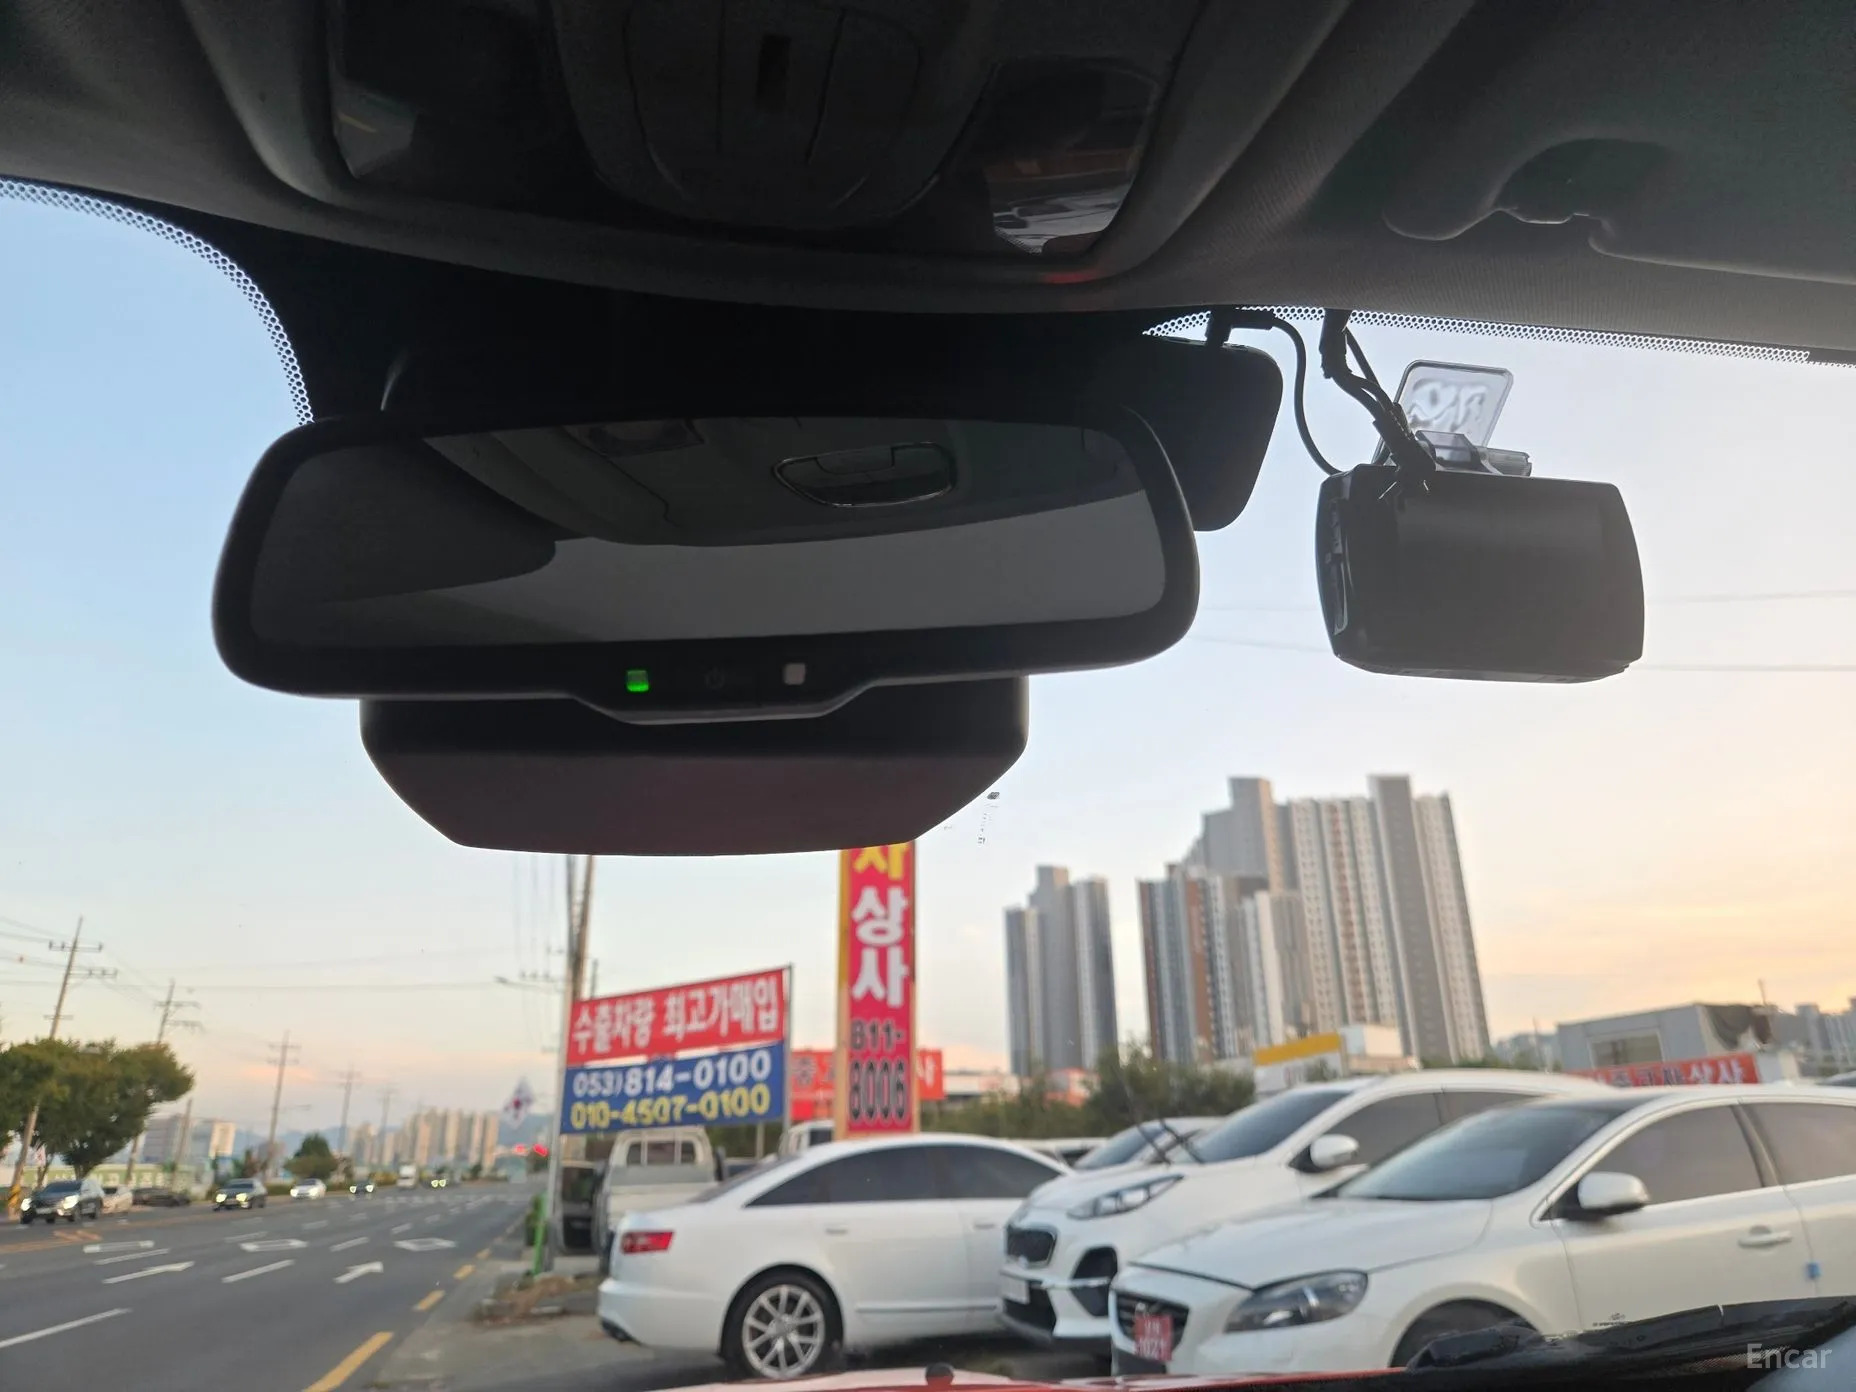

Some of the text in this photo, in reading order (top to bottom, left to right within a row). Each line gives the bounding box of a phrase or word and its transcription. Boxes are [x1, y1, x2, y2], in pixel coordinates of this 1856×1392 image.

[573, 976, 778, 1054] 수출차량 최고가매입
[572, 1049, 772, 1098] 053)814-0100
[570, 1083, 771, 1129] 010-4507-0100
